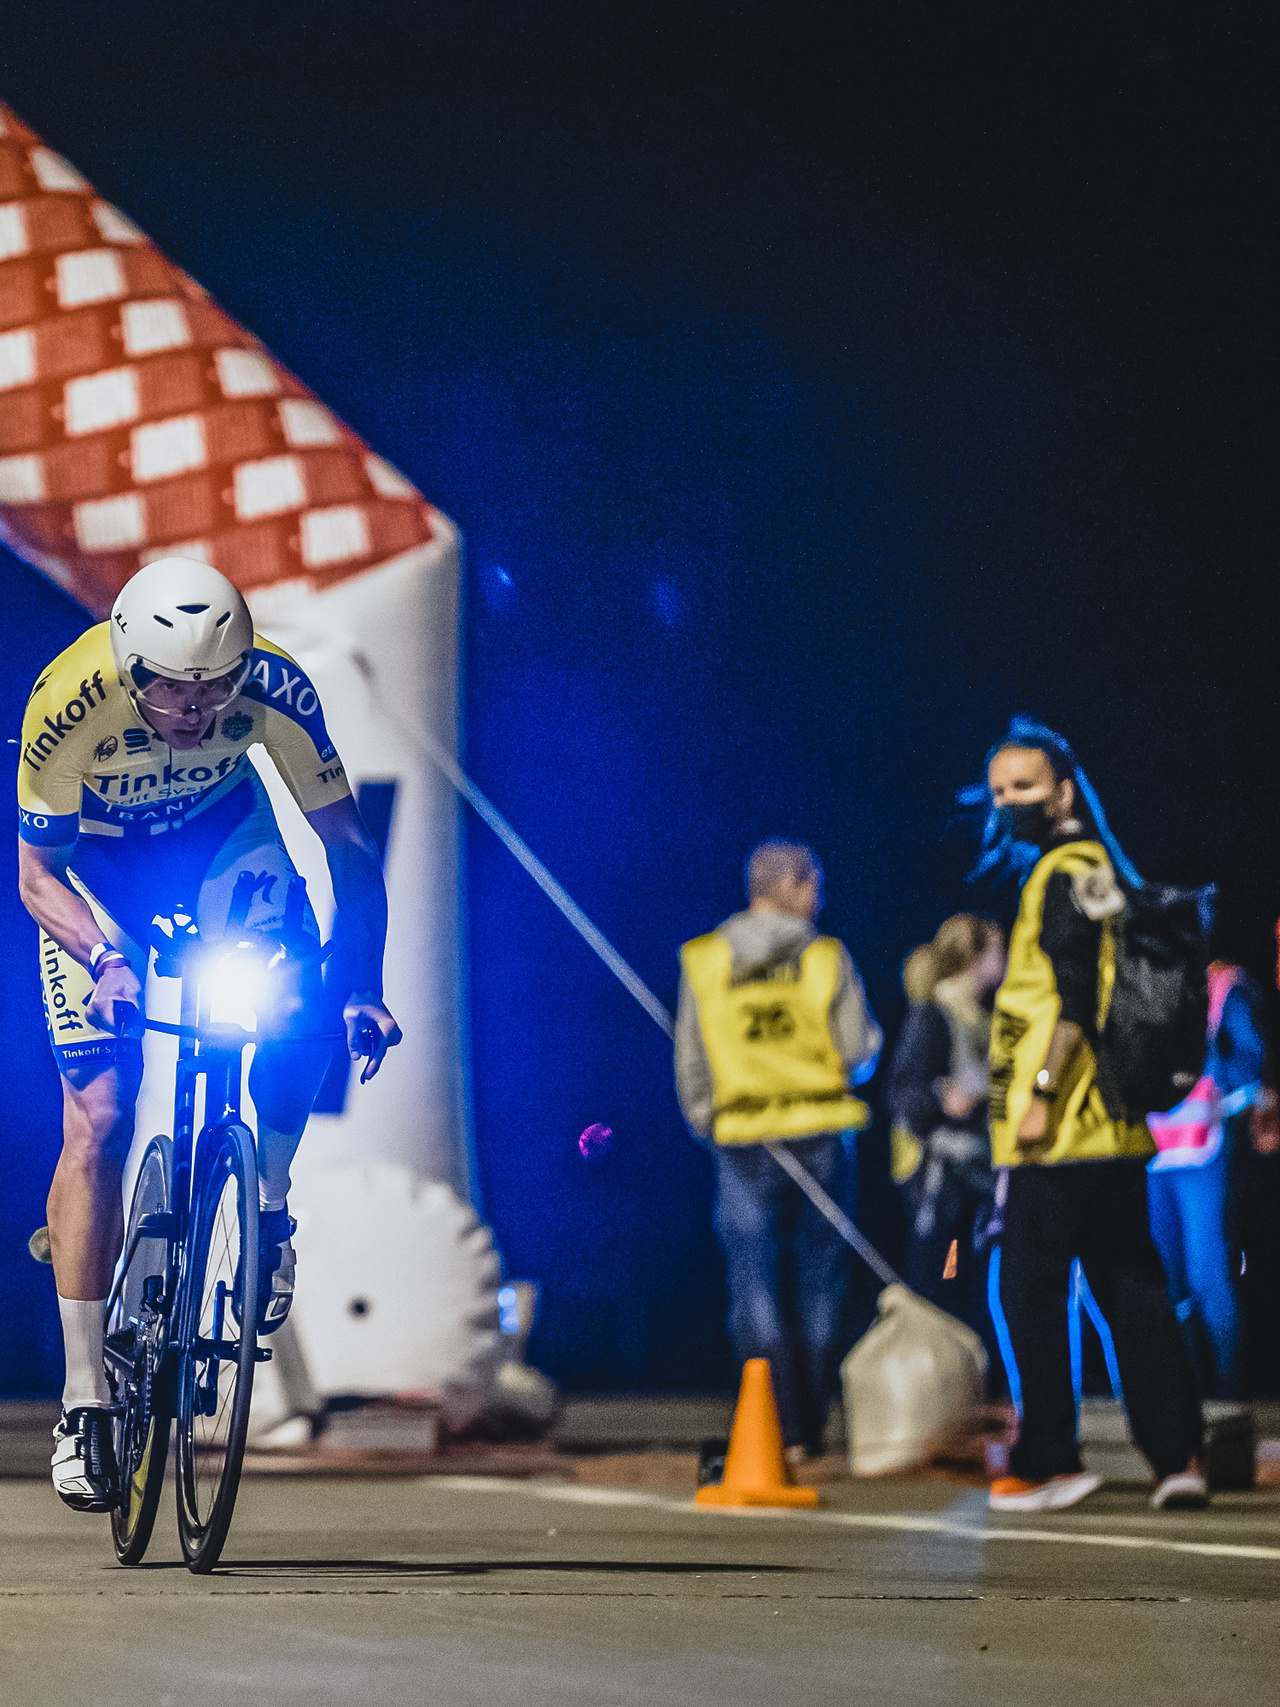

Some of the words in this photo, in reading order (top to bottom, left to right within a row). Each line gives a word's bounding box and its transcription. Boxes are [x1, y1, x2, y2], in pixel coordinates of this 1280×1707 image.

[250, 659, 319, 716] AXO
[23, 669, 107, 771] Tinkoff
[316, 766, 345, 784] Tin
[19, 807, 49, 829] XO
